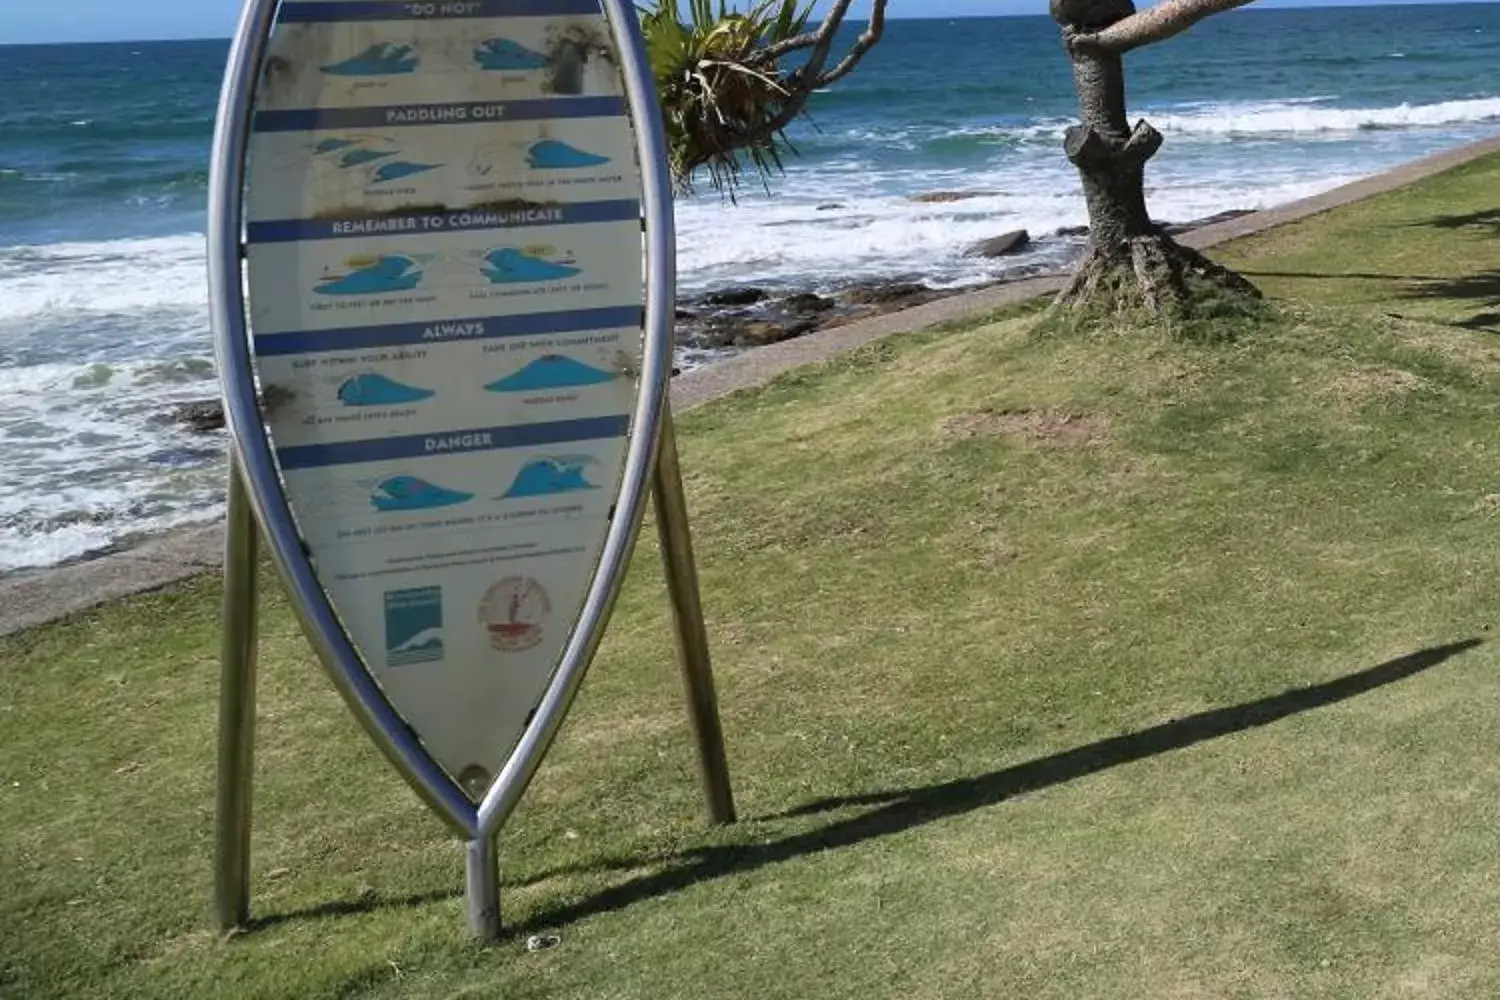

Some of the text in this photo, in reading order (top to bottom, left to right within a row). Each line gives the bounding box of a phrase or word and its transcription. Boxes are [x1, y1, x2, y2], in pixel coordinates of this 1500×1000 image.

[386, 105, 506, 122] PADDLING OUT
[332, 208, 563, 234] REMEMBER TO COMMUNICATE
[422, 323, 485, 339] ALWAYS
[424, 433, 493, 450] DANGER
